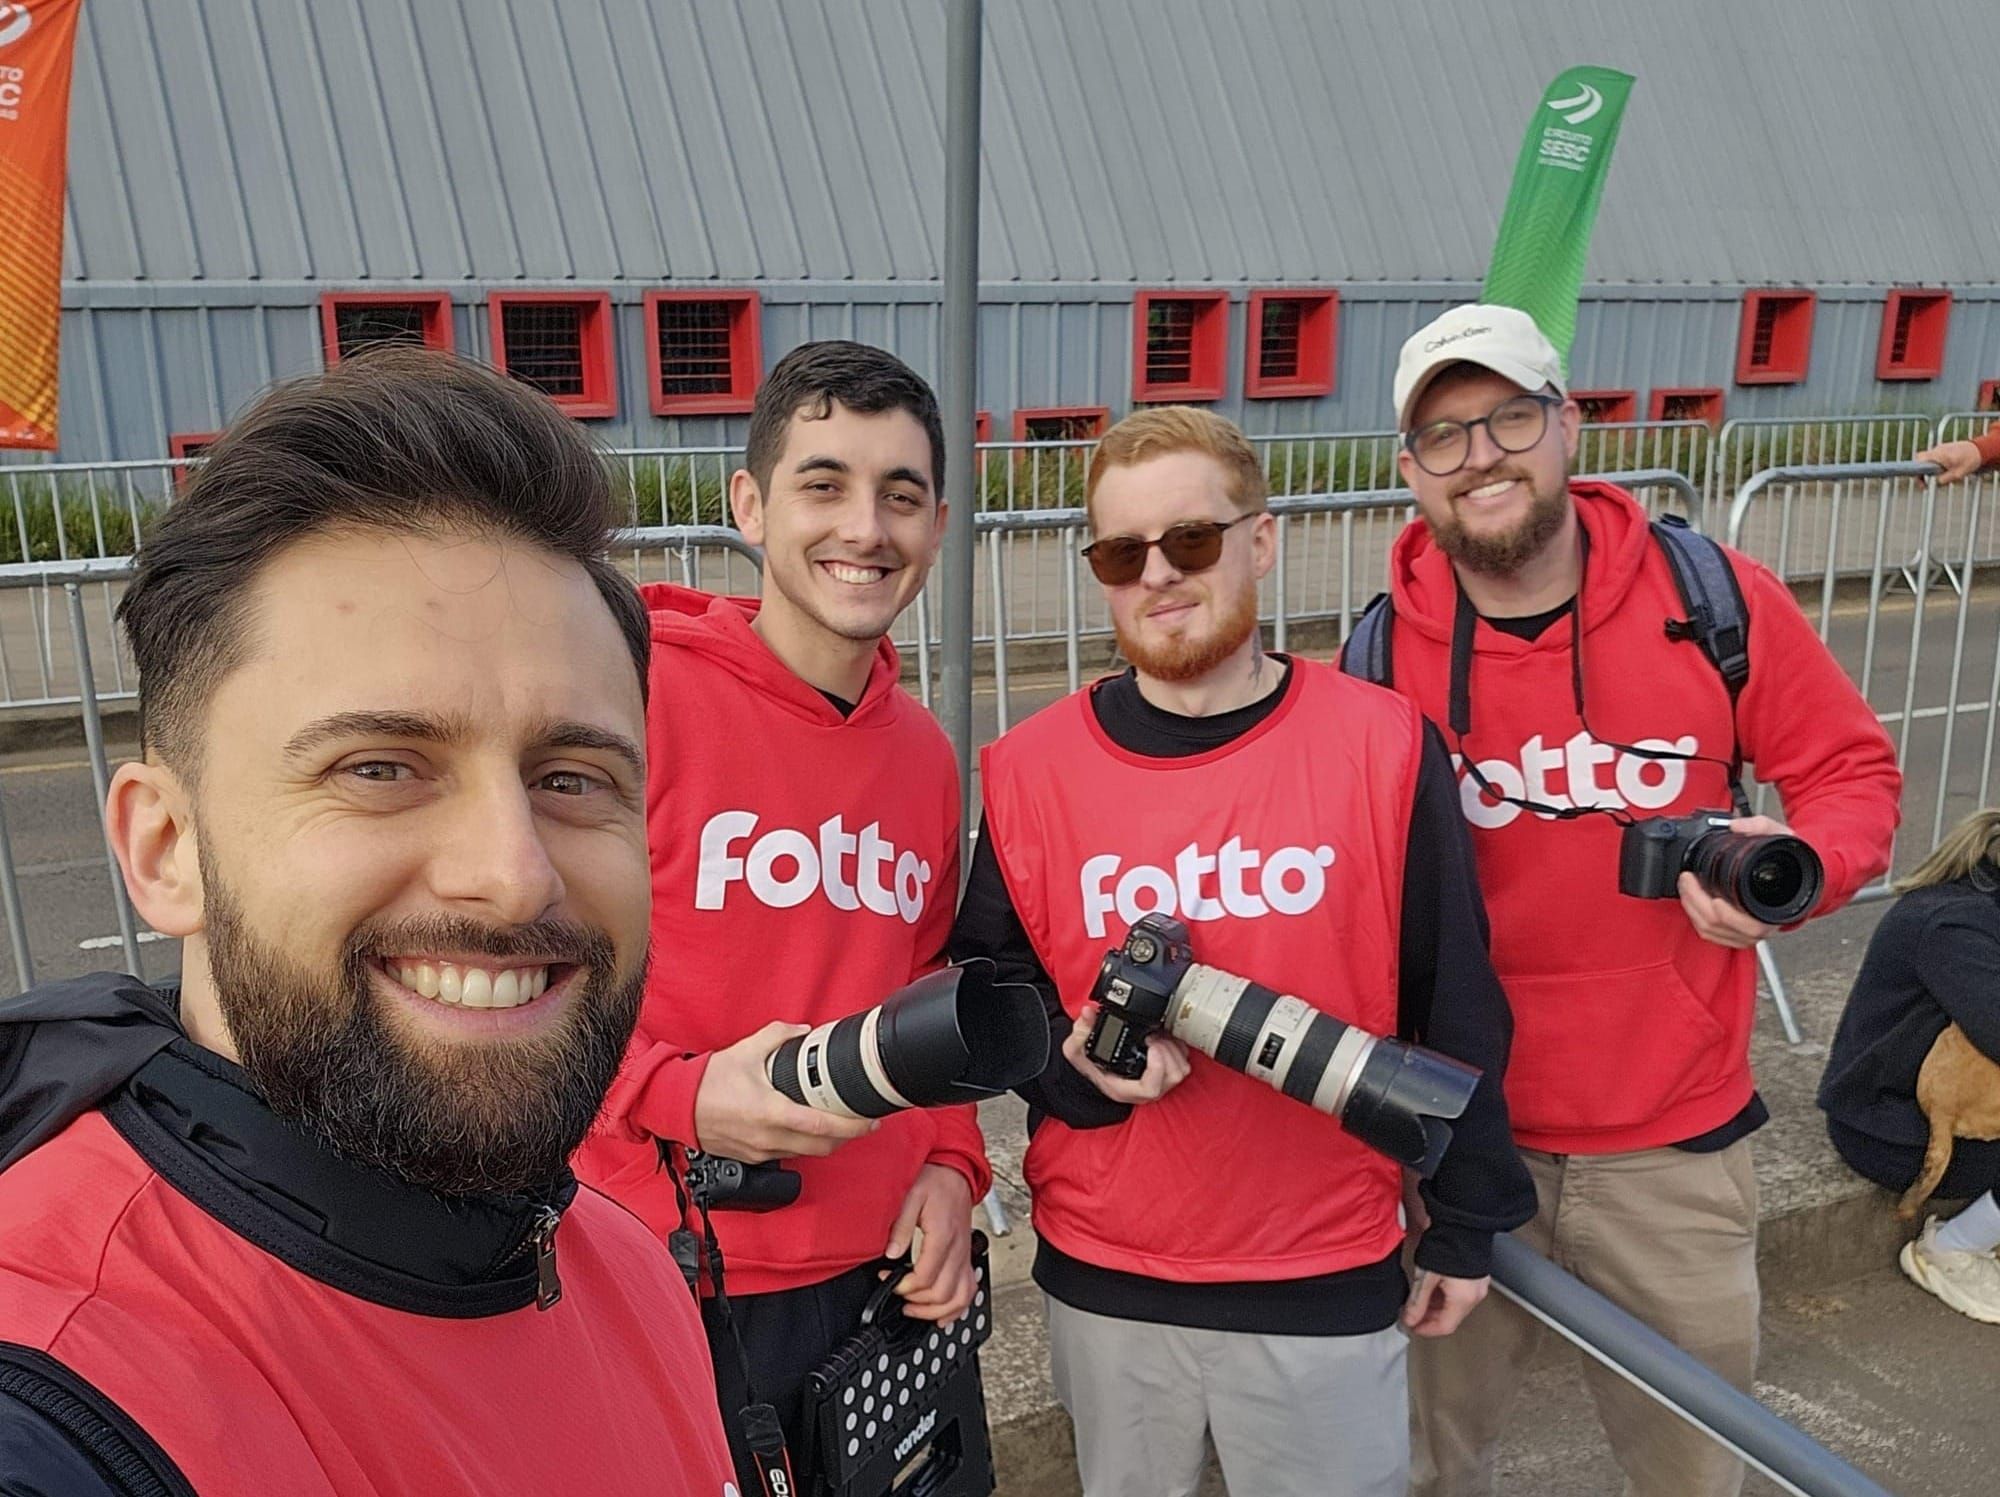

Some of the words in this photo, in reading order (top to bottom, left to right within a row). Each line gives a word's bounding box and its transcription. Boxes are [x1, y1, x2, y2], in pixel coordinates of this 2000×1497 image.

[1539, 139, 1590, 162] SESC
[1452, 731, 1698, 829] otto
[695, 810, 931, 924] fotto
[1080, 835, 1336, 939] fotto
[894, 1409, 936, 1461] vonder
[769, 1468, 790, 1497] EO
